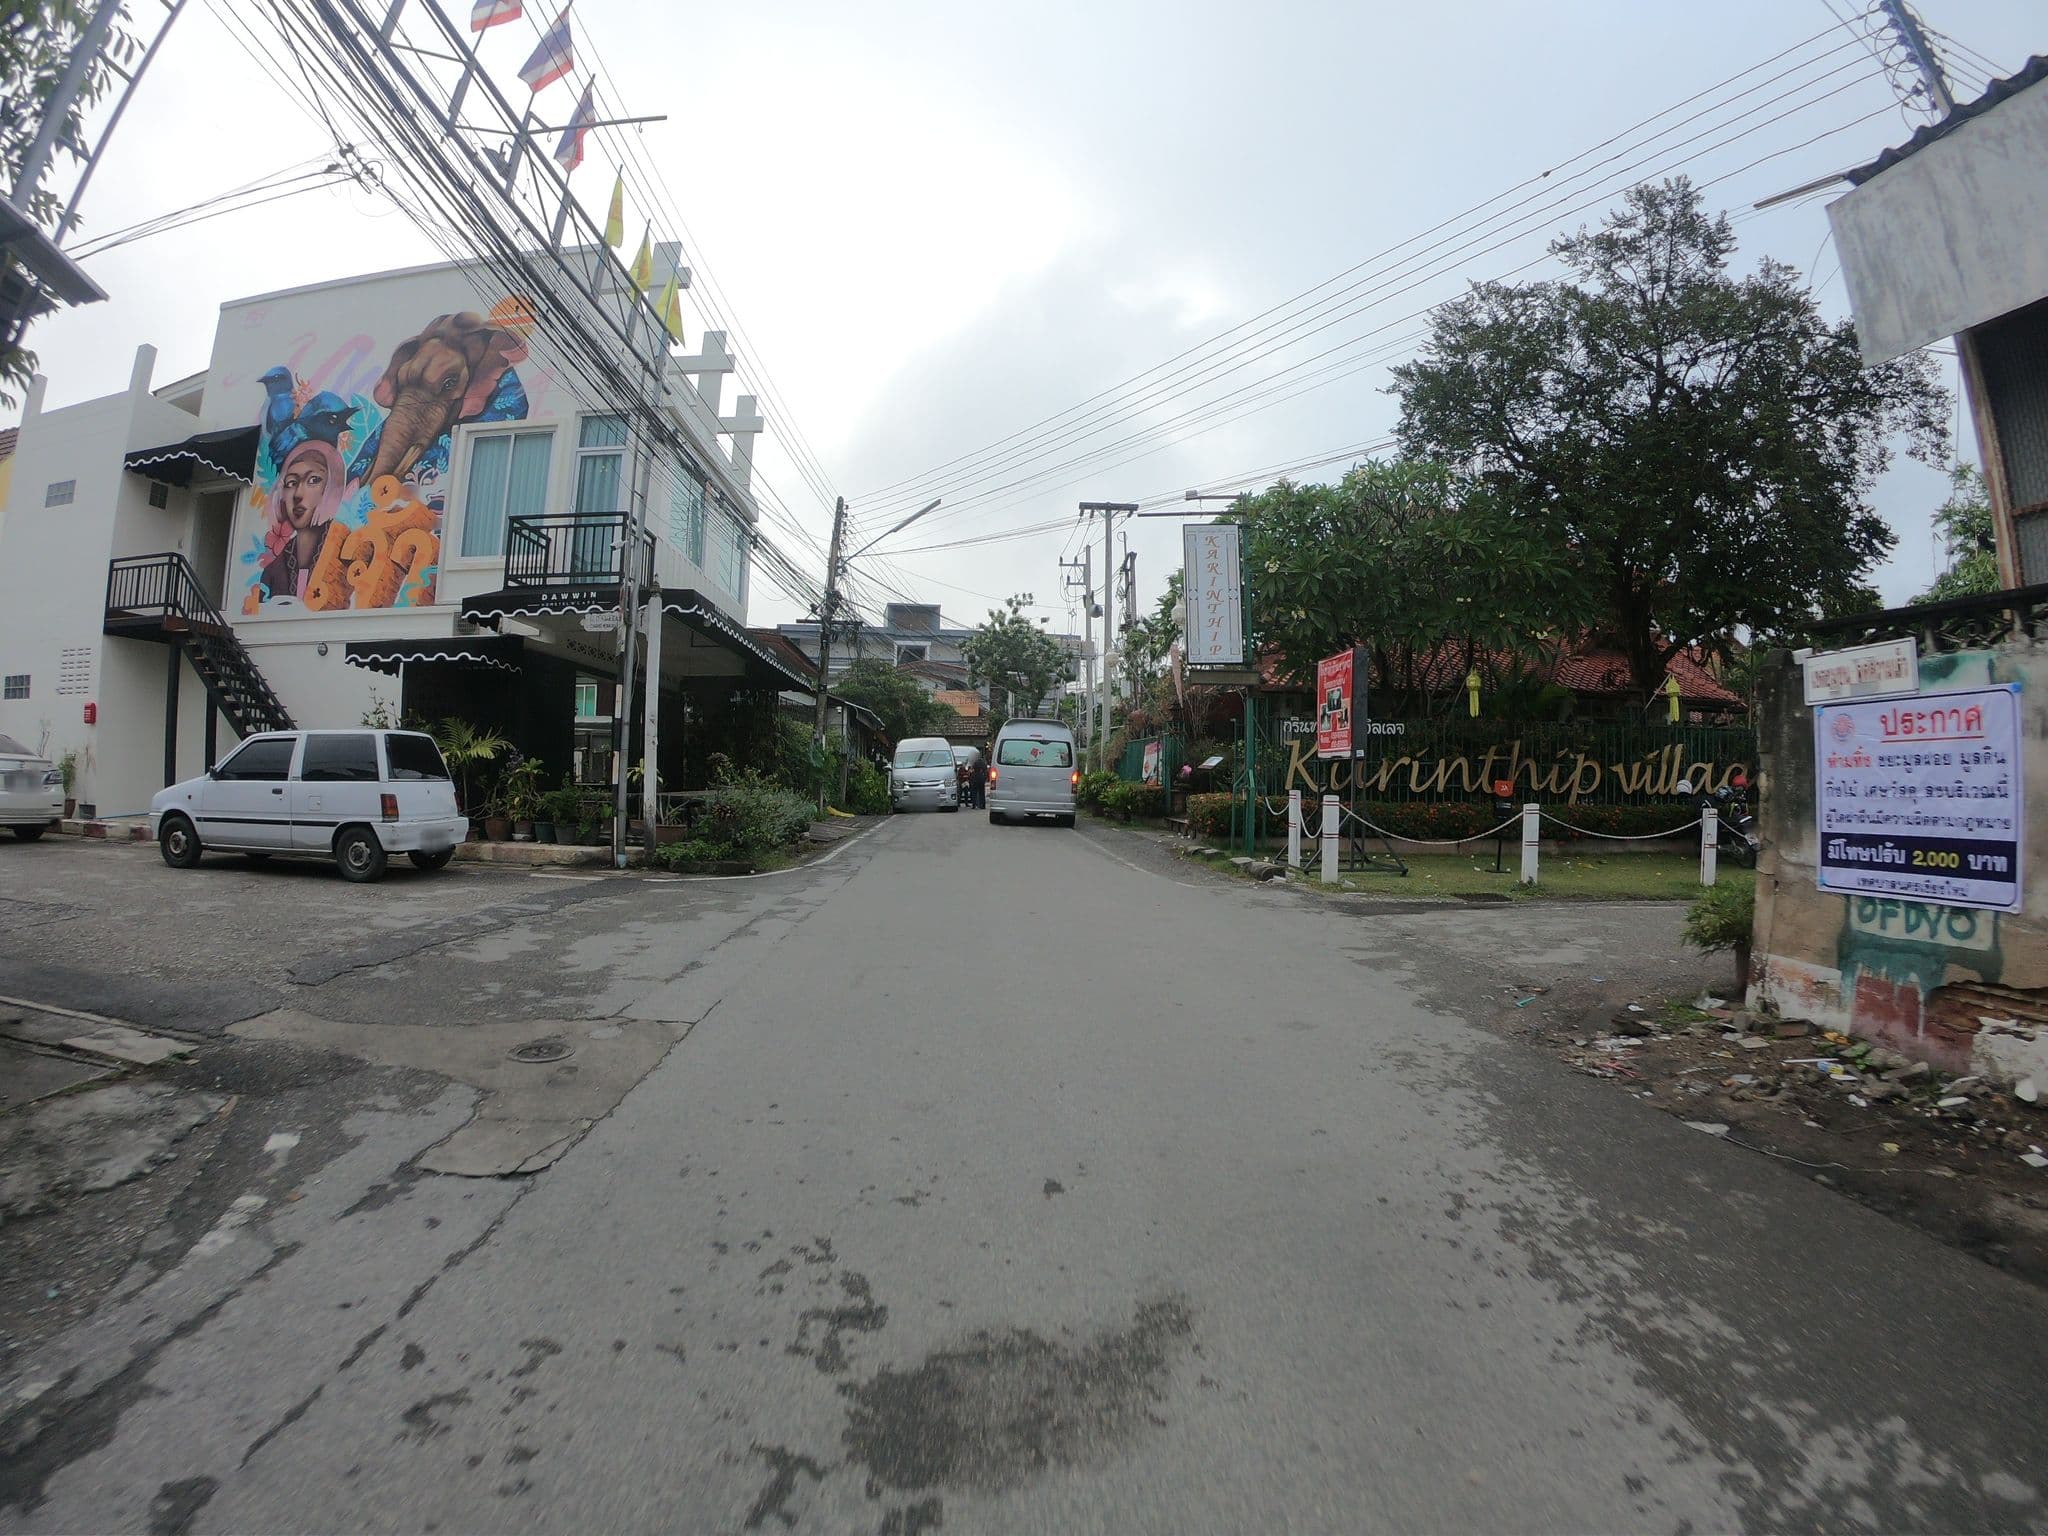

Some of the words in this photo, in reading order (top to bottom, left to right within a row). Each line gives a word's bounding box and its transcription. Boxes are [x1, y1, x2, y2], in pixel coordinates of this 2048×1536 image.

[541, 591, 597, 601] DAWWIN
[1205, 535, 1224, 655] KARINTHIP
[1880, 704, 1983, 736] ประกาศ
[1826, 746, 1873, 768] ห้ามทิ้ง
[1878, 753, 1952, 774] ขยะมูลฝอย
[1827, 838, 1906, 865] มีโทษปรับ
[1967, 853, 2009, 873] บาท
